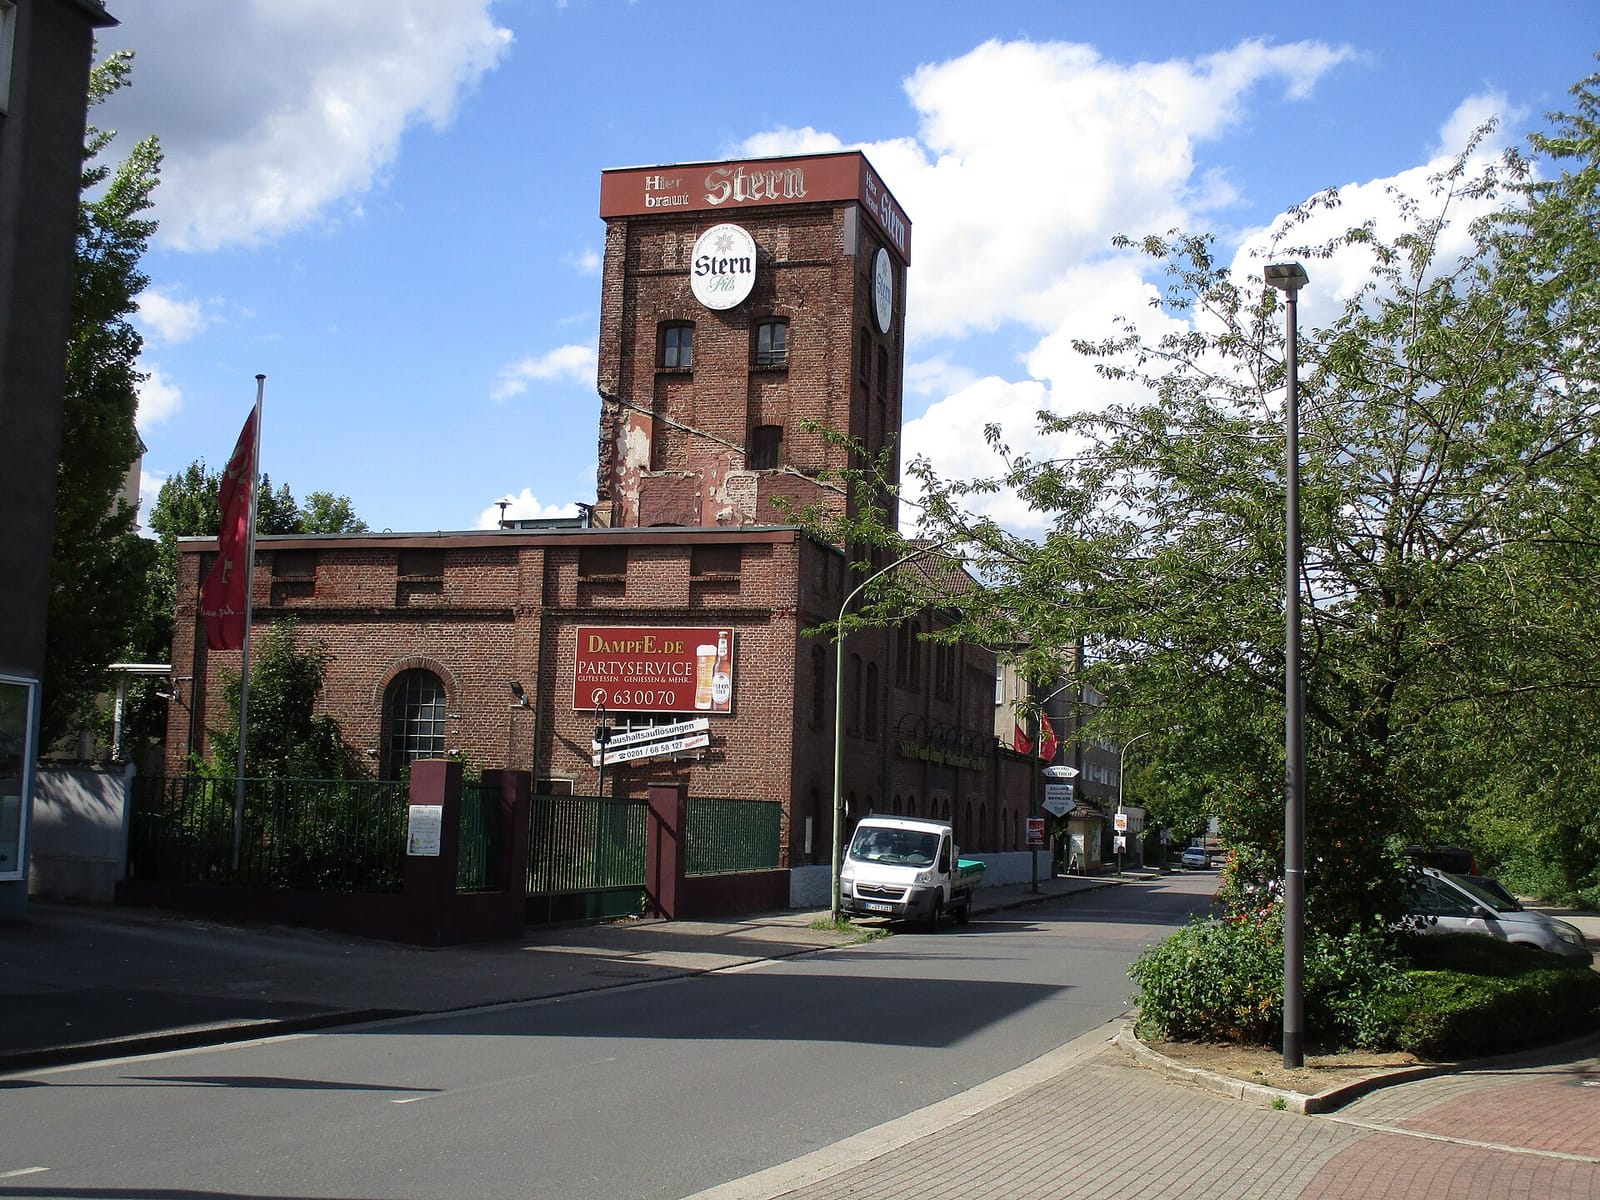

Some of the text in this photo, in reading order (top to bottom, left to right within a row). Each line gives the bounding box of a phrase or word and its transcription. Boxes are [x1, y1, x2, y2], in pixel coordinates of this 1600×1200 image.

[645, 175, 682, 191] Hier
[703, 166, 808, 206] Stern
[880, 193, 905, 253] Stern
[694, 255, 751, 277] Stern
[706, 274, 736, 293] Pils
[578, 661, 692, 676] PARTYSERVICE
[613, 690, 675, 706] 63 00 70
[626, 748, 643, 759] 0201
[649, 745, 659, 754] 68
[660, 743, 670, 752] 58
[671, 741, 683, 750] 127
